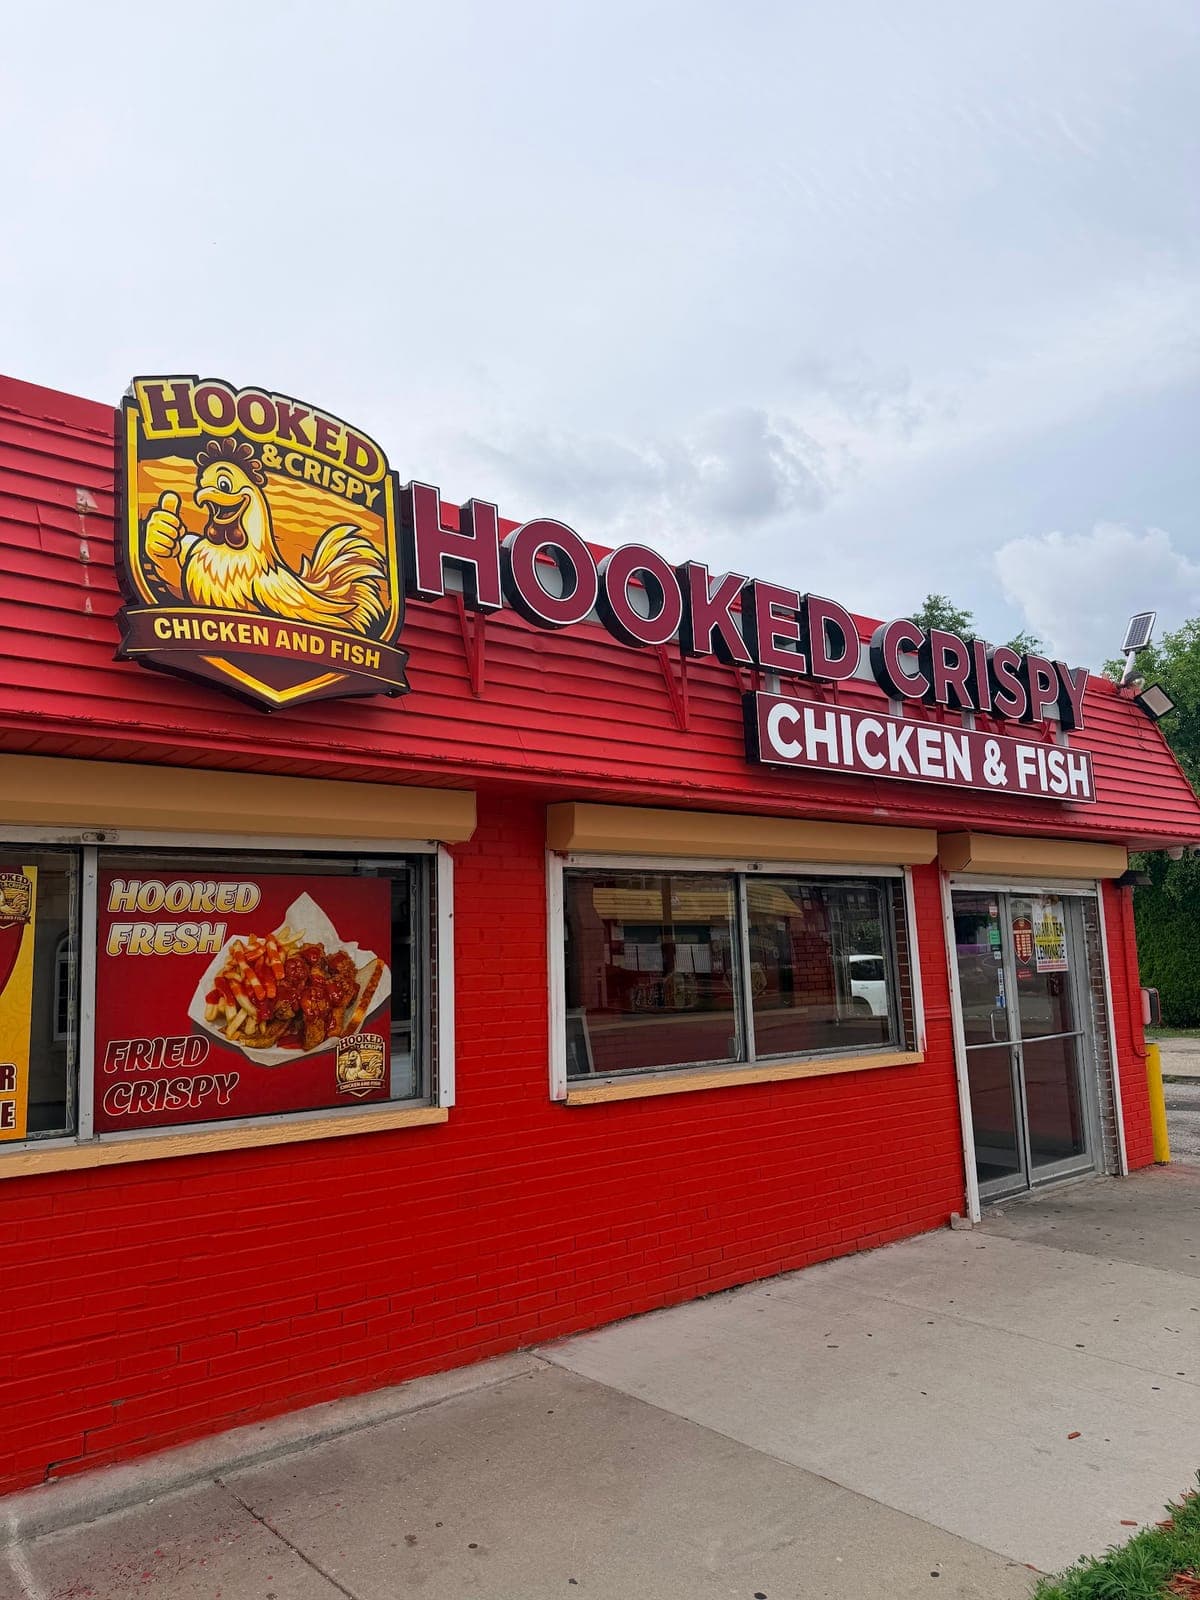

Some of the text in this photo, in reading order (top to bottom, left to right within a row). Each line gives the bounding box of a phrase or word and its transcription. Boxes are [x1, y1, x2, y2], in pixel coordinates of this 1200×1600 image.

[143, 383, 379, 475] HOOKED
[262, 443, 381, 507] &CRISPY
[410, 480, 1089, 730] HOOKED CRISPY
[153, 617, 380, 669] CHICKEN AND FISH
[767, 702, 1091, 797] CHICKEN & FISH
[0, 875, 29, 884] OKED
[107, 879, 262, 914] HOOKED
[107, 922, 228, 956] FRESH
[103, 1035, 210, 1074] FRIED
[340, 1034, 383, 1049] HOOKED
[103, 1072, 240, 1116] CRISPY
